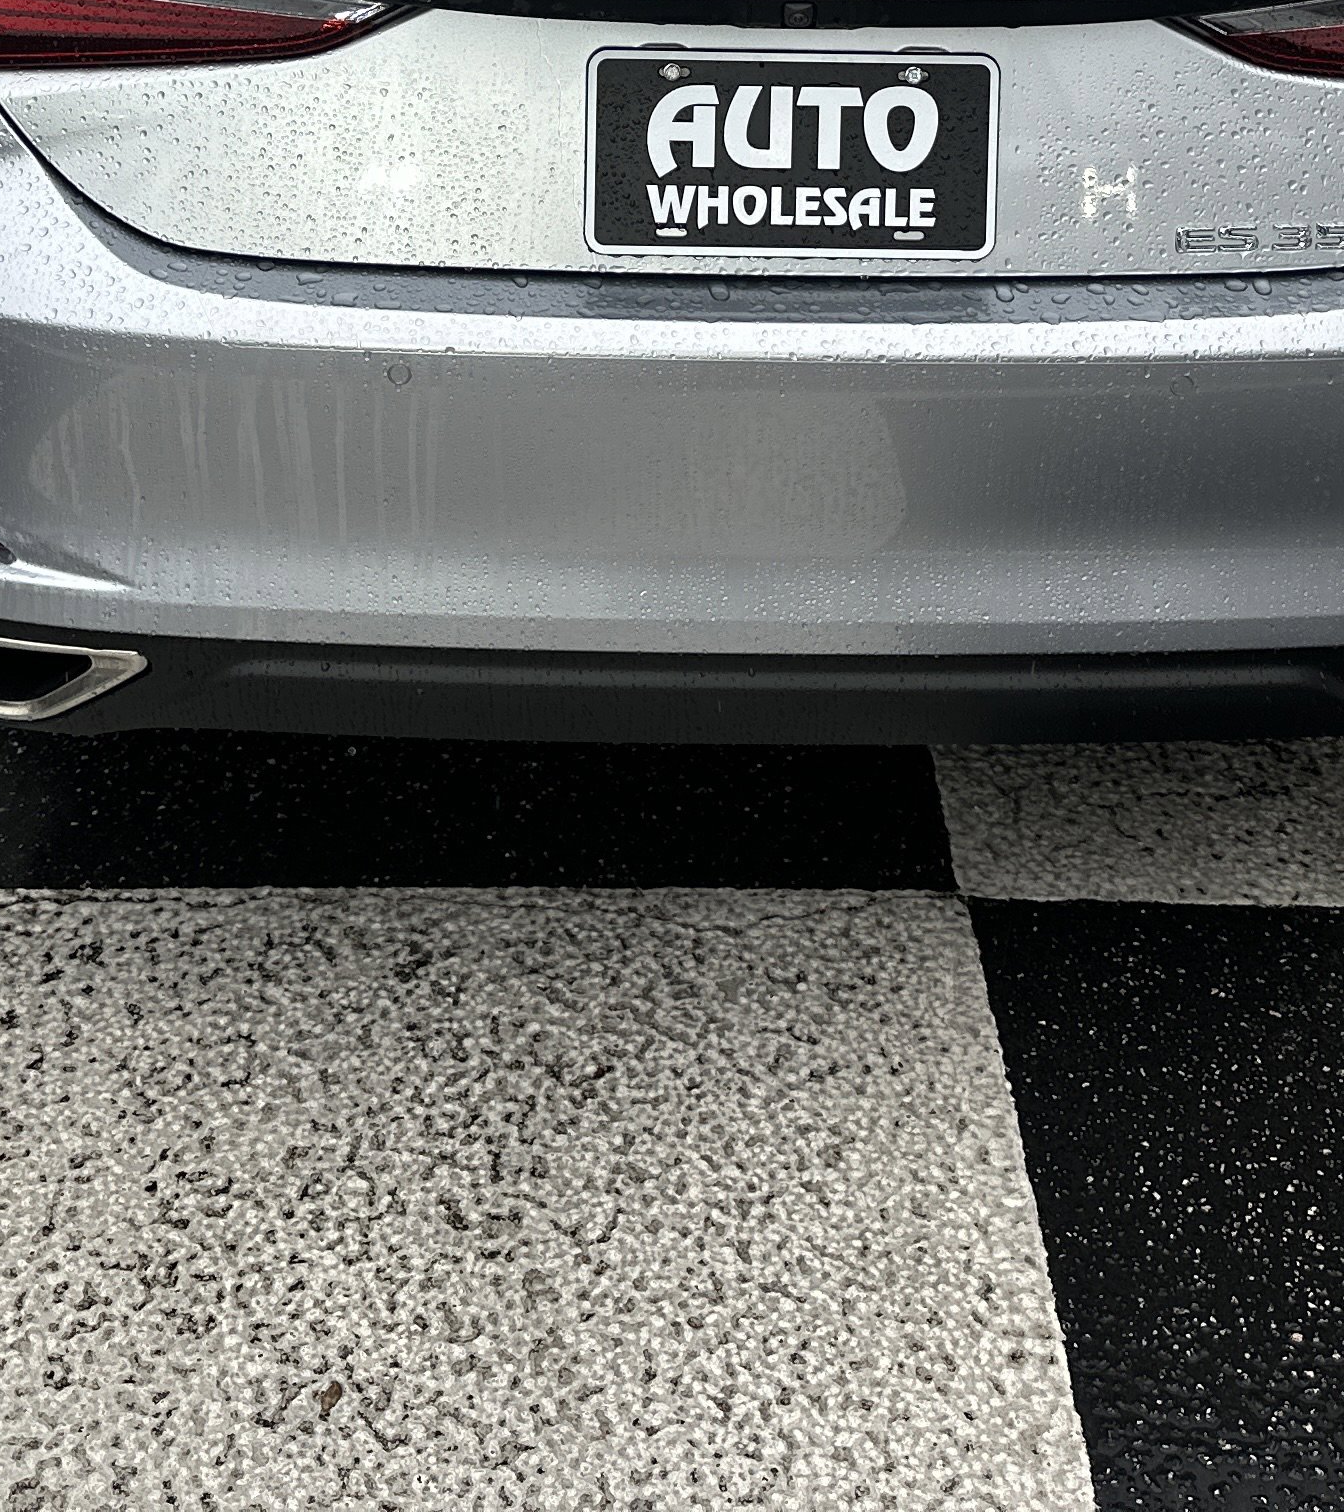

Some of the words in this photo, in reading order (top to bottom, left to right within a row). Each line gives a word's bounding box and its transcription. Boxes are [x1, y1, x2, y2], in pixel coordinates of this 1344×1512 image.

[646, 85, 939, 178] AUTO
[646, 185, 937, 231] WHOLESALE
[1175, 226, 1259, 253] ES
